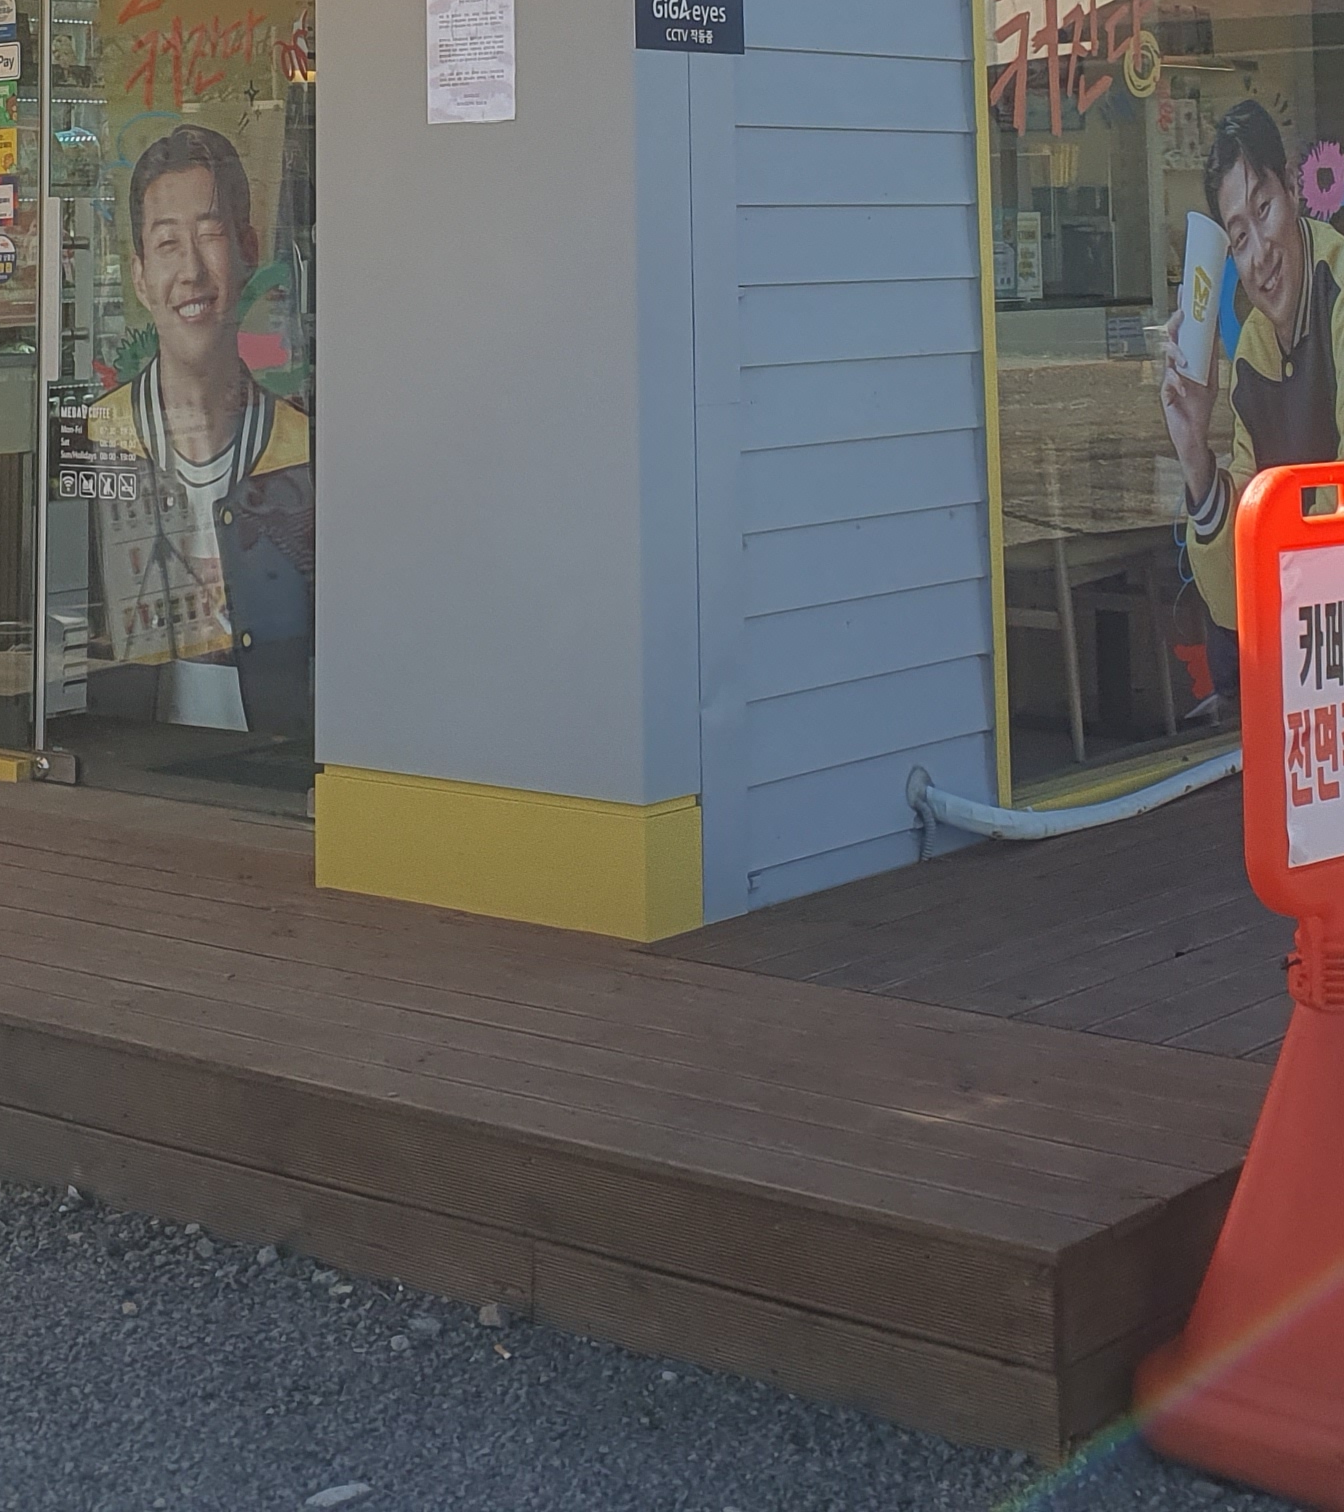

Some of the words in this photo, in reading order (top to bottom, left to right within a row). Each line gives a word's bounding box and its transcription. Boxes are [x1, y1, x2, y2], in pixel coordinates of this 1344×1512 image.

[125, 8, 267, 110] 커진다
[666, 28, 689, 42] CCTV
[690, 29, 713, 44] 작동중
